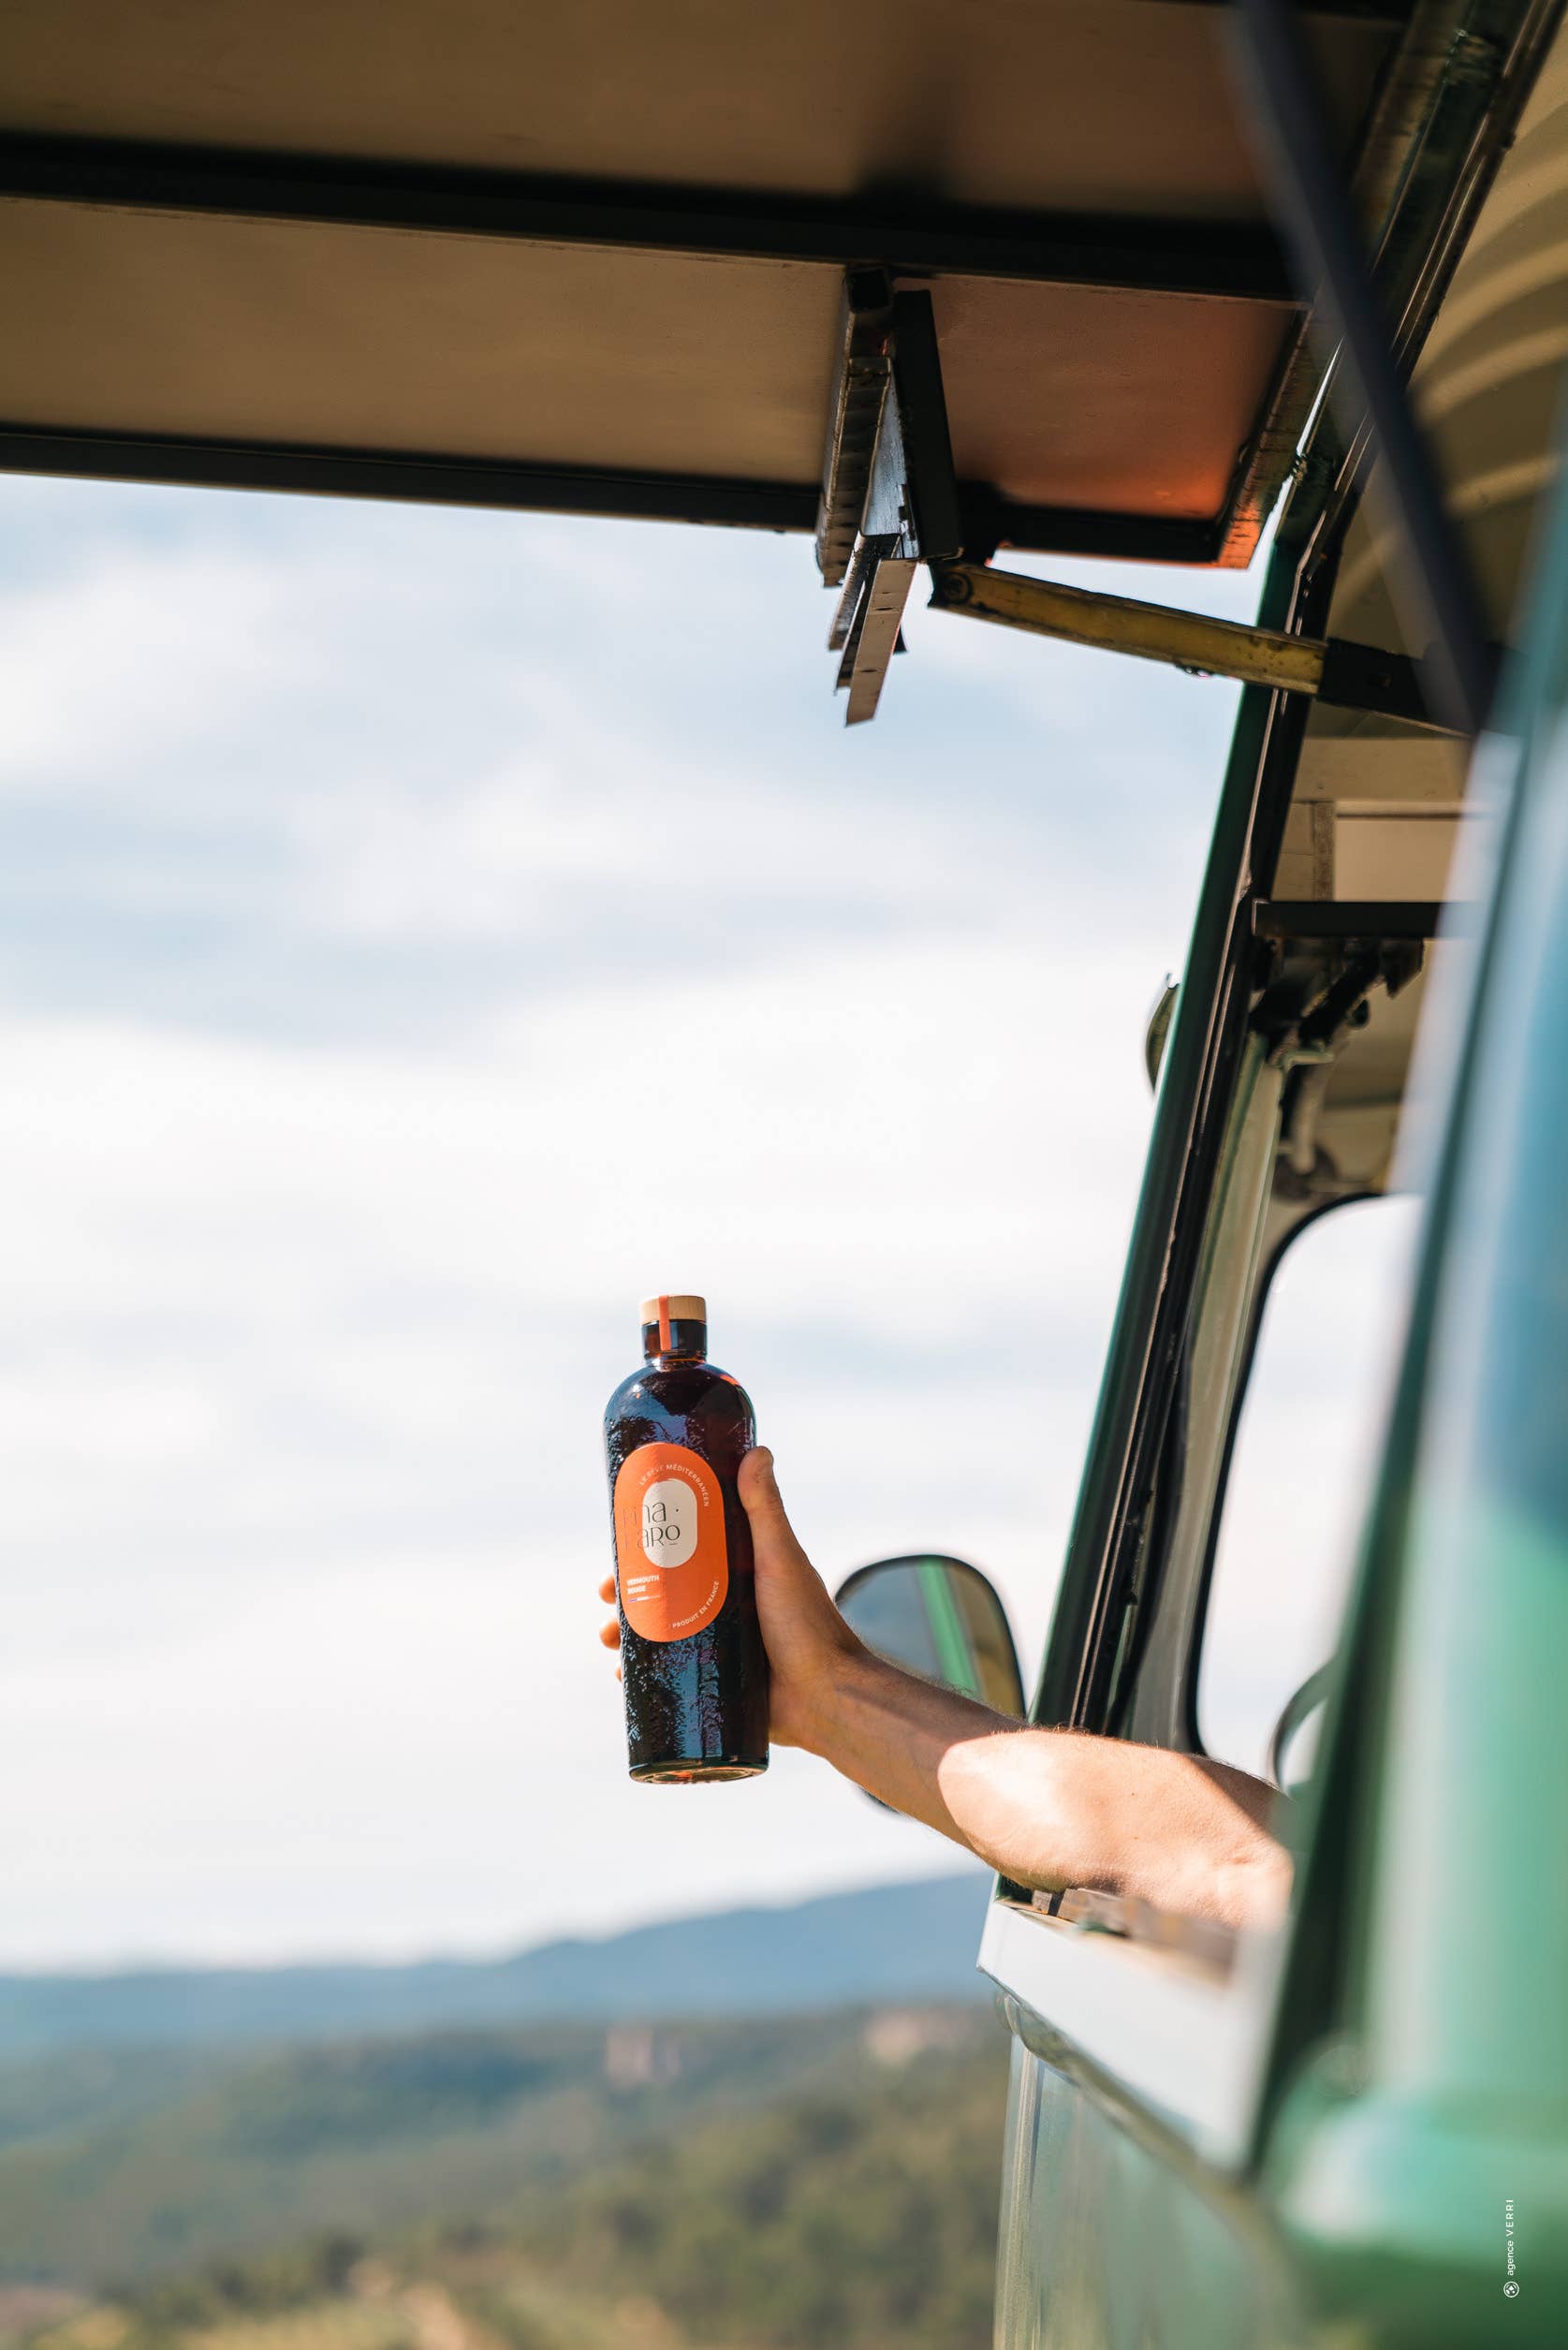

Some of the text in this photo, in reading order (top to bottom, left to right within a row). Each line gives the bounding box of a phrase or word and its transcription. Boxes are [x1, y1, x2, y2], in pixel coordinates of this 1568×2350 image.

[672, 1580, 720, 1628] PRODUIT EN FRANCE
